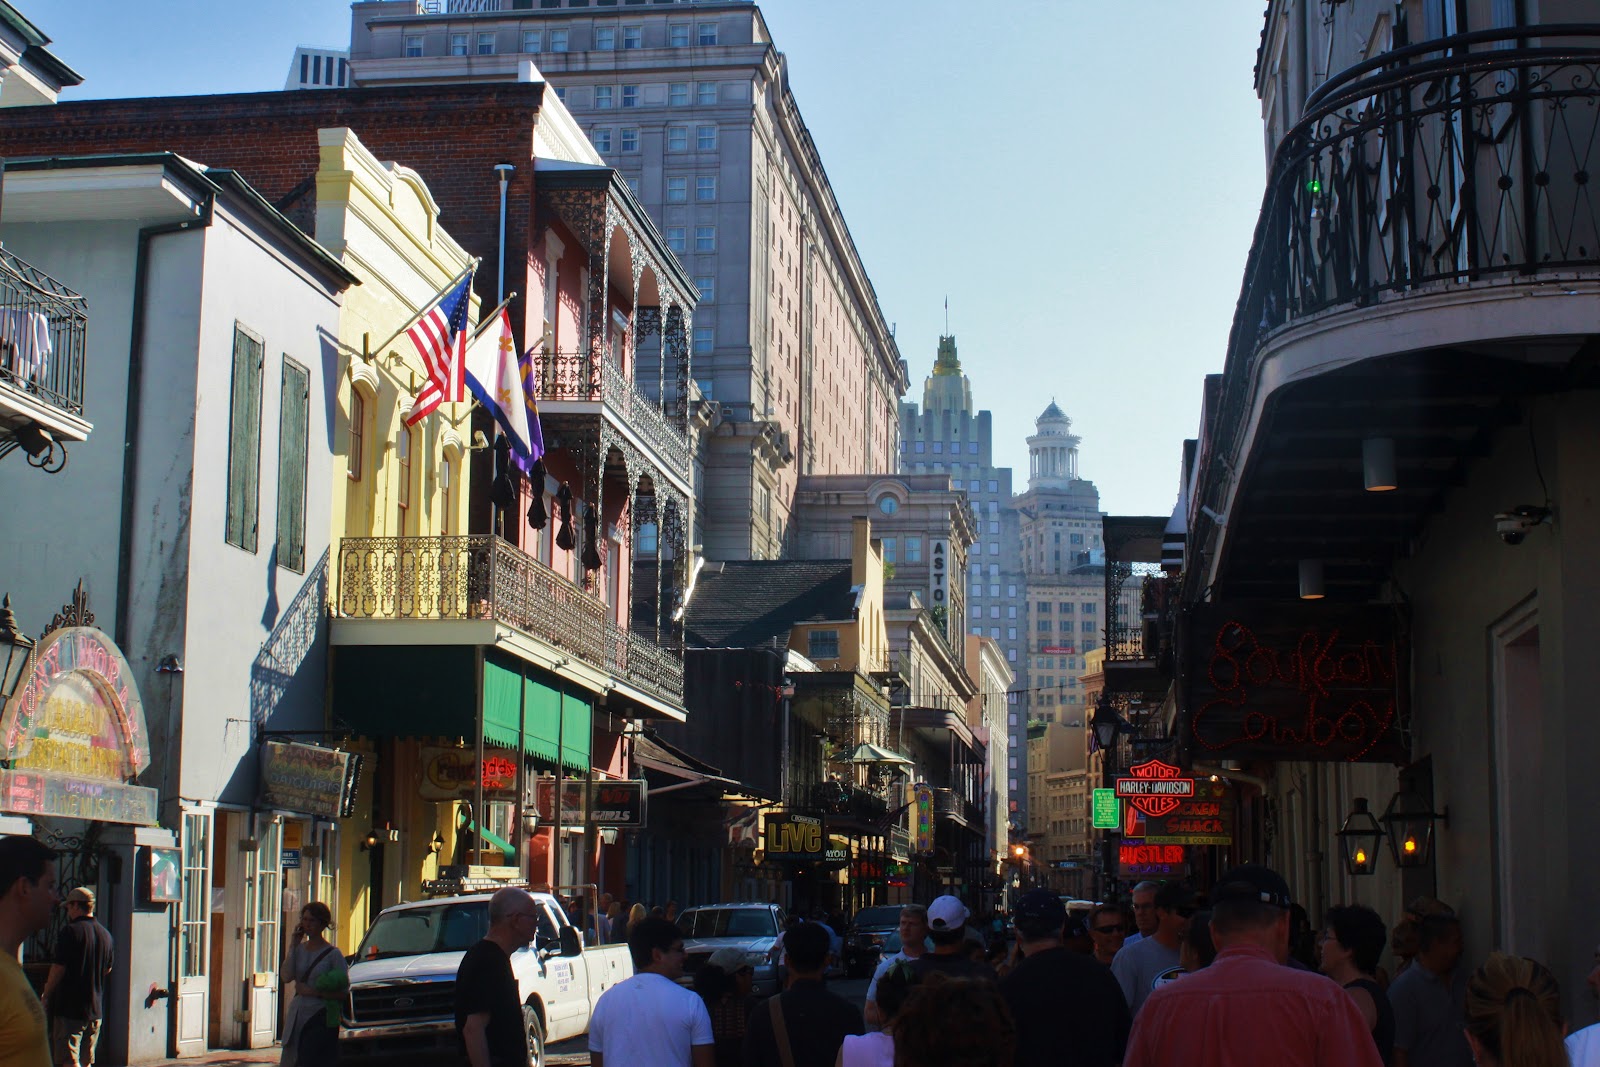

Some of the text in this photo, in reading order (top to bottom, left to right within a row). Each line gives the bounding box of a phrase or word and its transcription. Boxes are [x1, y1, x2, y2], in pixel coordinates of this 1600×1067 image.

[1136, 766, 1175, 778] MOTOR
[1119, 780, 1191, 795] HARLEY-DAVIDSON
[1136, 797, 1175, 814] CYCLES
[1166, 817, 1225, 834] SHACK
[1192, 836, 1211, 845] COLD
[1119, 845, 1184, 864] HUSTLER
